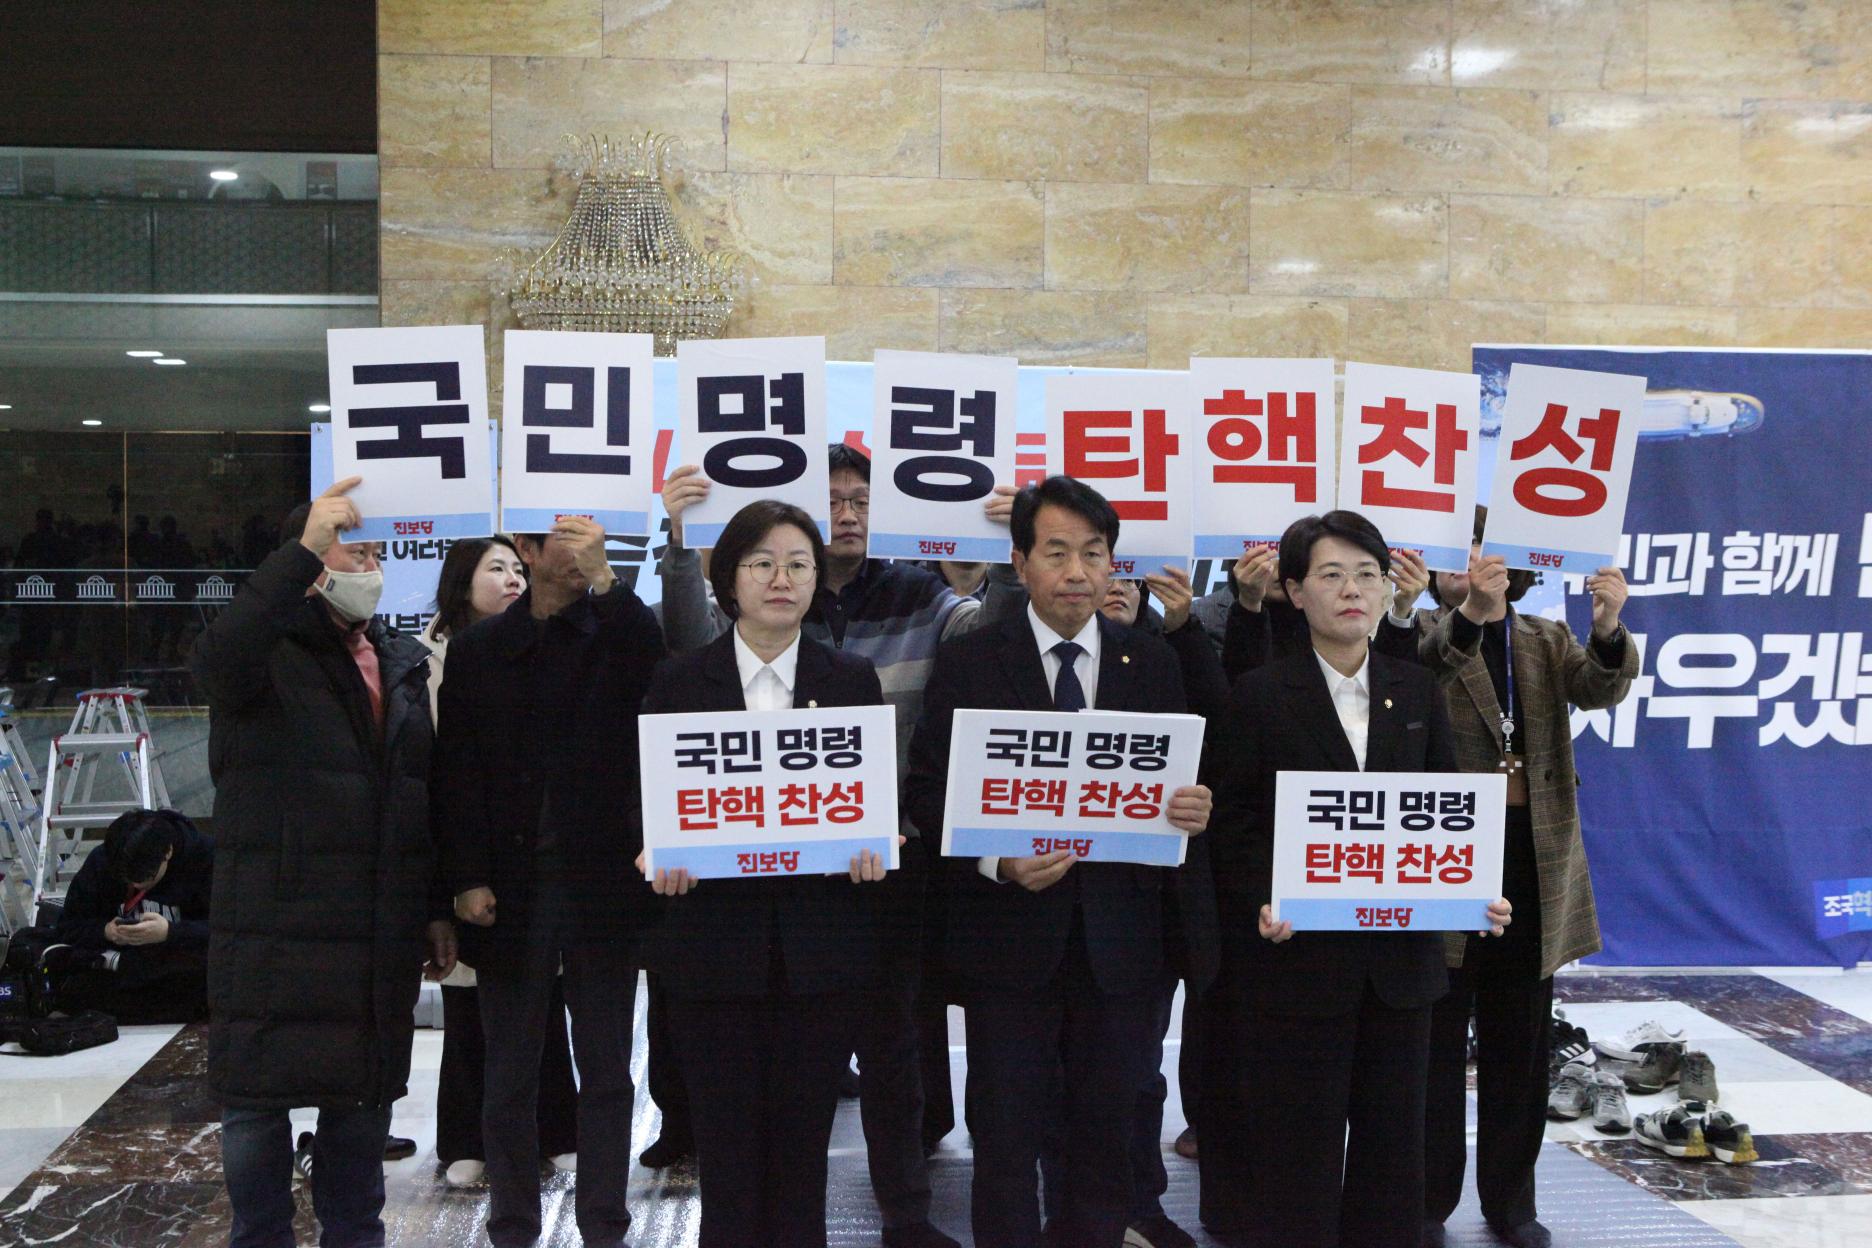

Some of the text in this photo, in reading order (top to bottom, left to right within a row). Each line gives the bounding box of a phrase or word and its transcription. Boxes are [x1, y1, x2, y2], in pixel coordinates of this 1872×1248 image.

[348, 362, 469, 479] 국
[523, 365, 631, 475] 민
[697, 372, 808, 488] 명
[890, 386, 997, 502] 령
[1063, 409, 1179, 520] 탄
[1203, 389, 1317, 503] 핵
[1358, 396, 1469, 512] 찬
[1511, 403, 1621, 517] 성
[394, 521, 434, 535] 진보당
[918, 540, 957, 555] 진보당
[1528, 552, 1564, 568] 진보당
[1722, 531, 1839, 596] 함께
[674, 725, 863, 775] 국민 명령
[985, 728, 1171, 772] 국민 명령
[677, 780, 865, 831] 탄핵 찬성
[981, 778, 1164, 820] 탄핵 찬성
[1306, 789, 1476, 832] 국민 명령
[737, 850, 800, 874] 진보당
[1305, 843, 1474, 884] 탄핵 찬성
[1355, 907, 1414, 928] 진보당
